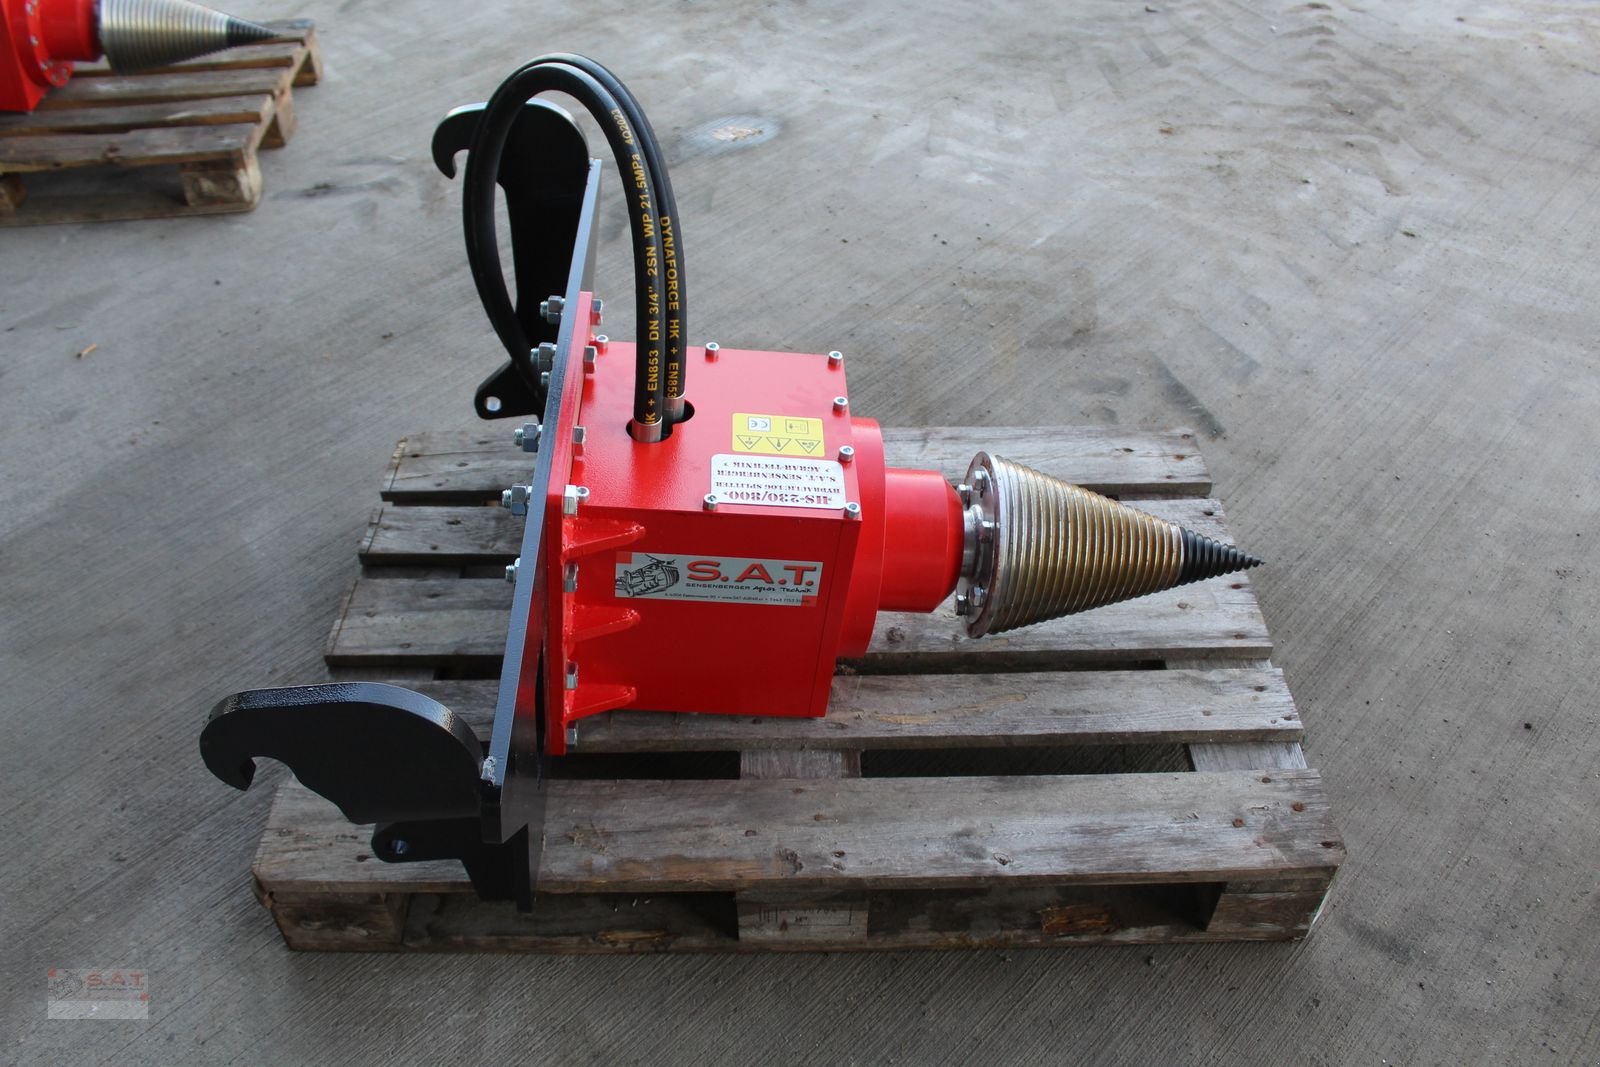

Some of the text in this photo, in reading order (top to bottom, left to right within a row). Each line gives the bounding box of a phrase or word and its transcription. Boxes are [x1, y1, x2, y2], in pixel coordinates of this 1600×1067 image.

[611, 108, 634, 145] 4Q2023
[632, 153, 651, 209] 21.5MPa
[643, 213, 655, 238] WP
[646, 246, 658, 277] 2SN
[660, 216, 679, 310] DYNAFORCE
[649, 320, 659, 341] DN
[669, 319, 680, 339] HK
[647, 349, 659, 391] EN853
[667, 362, 680, 398] EN853
[716, 469, 836, 483] S.A.T. SENSENBERGER
[732, 462, 821, 473] AGRAR-TECHNIK
[716, 481, 762, 489] SPLITTER
[687, 560, 818, 586] S.A.T.
[685, 582, 751, 590] SENSENBERGER
